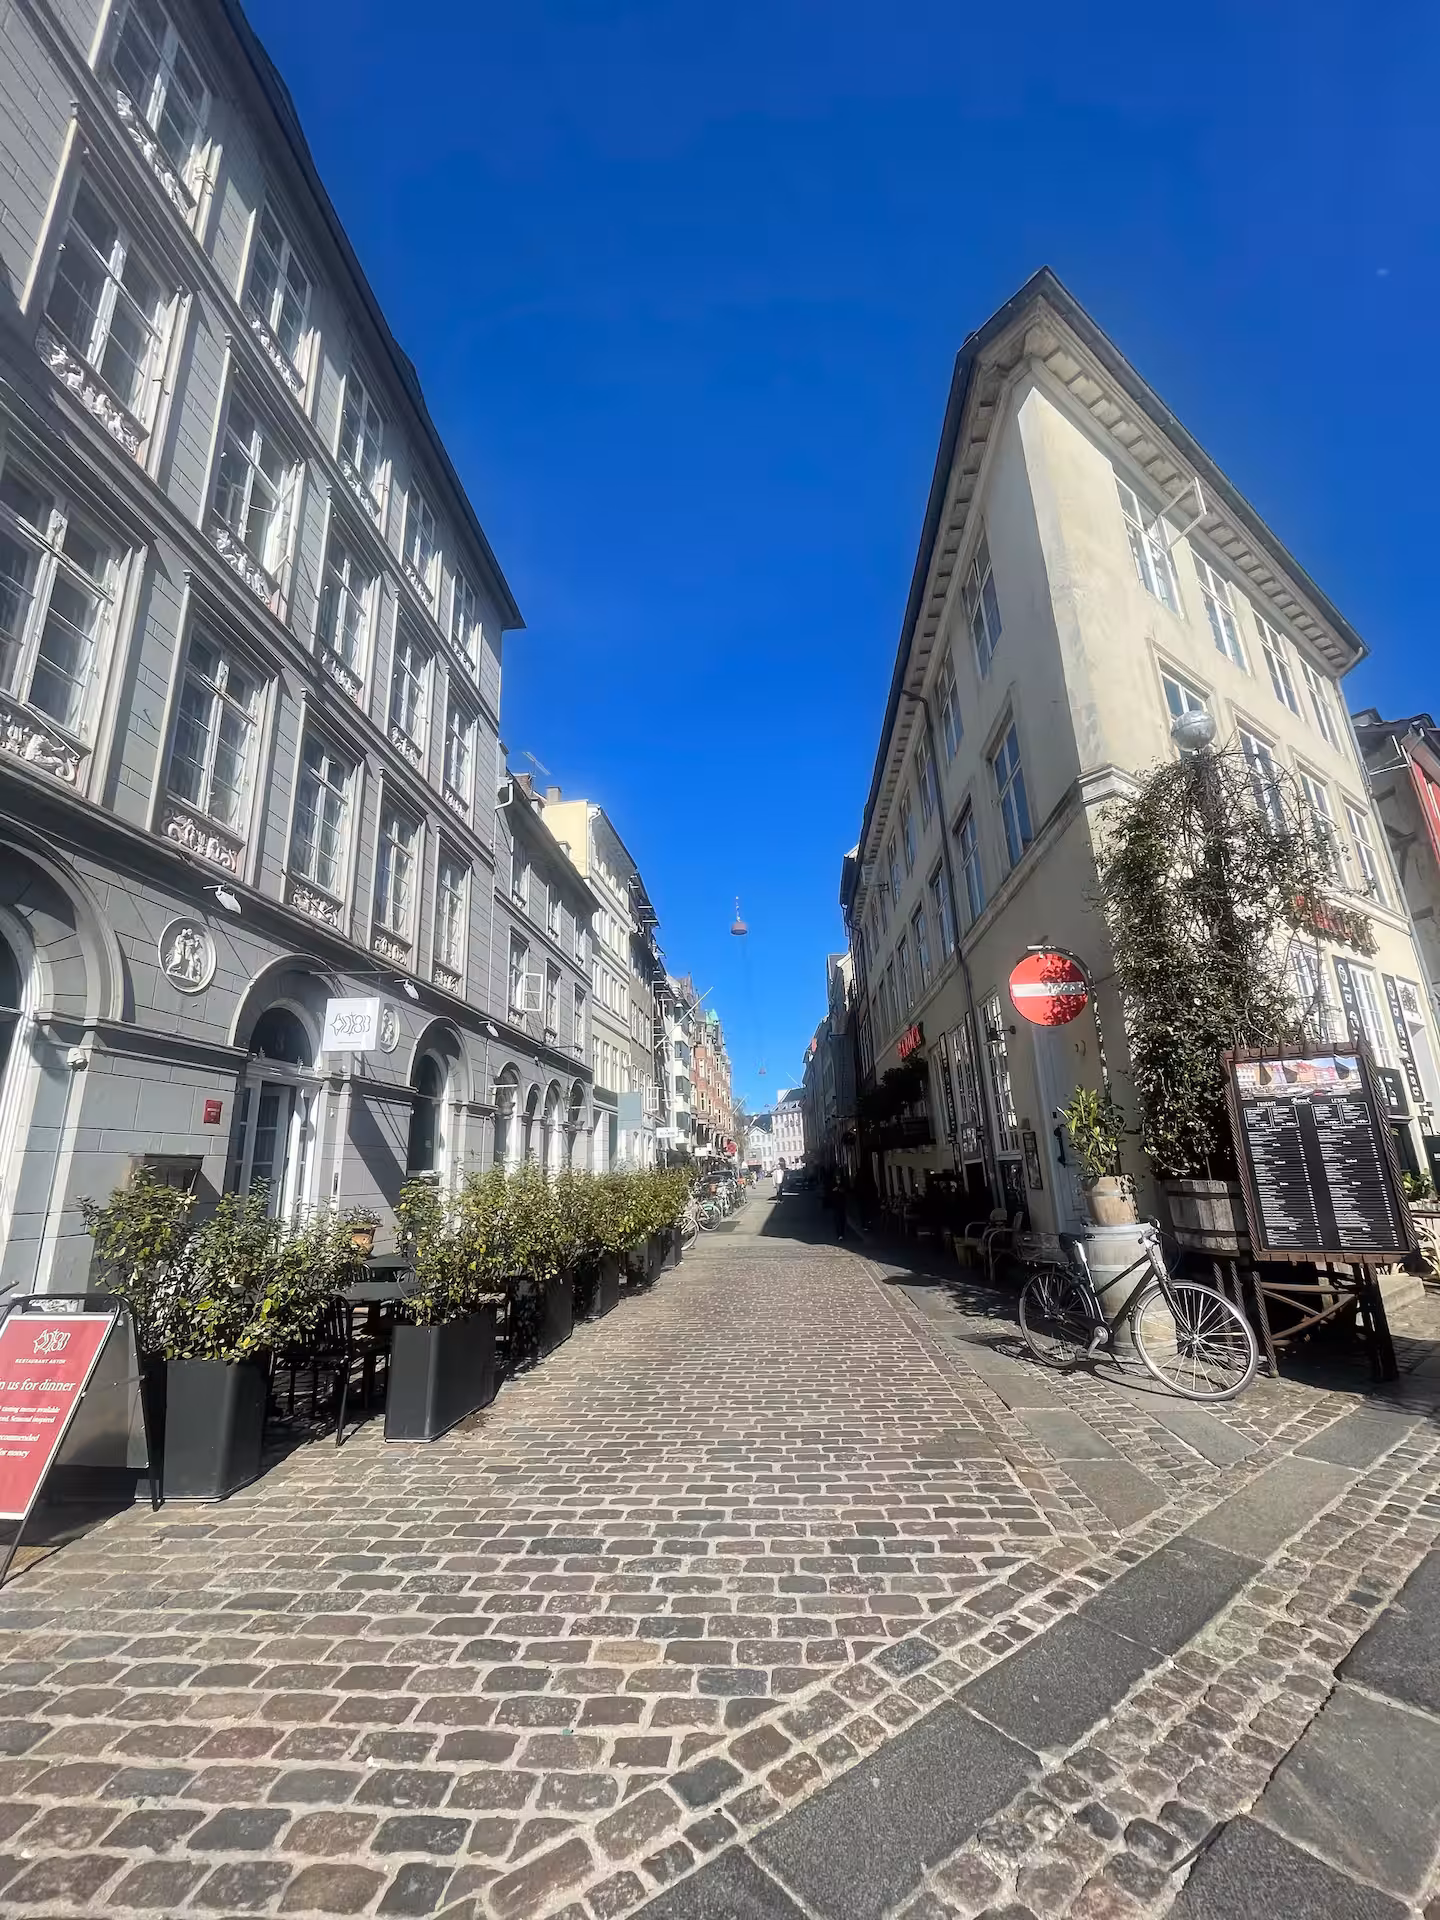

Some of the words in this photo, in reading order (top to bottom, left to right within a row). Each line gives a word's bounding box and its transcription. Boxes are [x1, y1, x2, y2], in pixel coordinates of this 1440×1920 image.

[7, 1381, 20, 1391] us
[19, 1377, 39, 1391] for
[38, 1378, 76, 1391] dinner
[0, 1434, 40, 1442] ecommended
